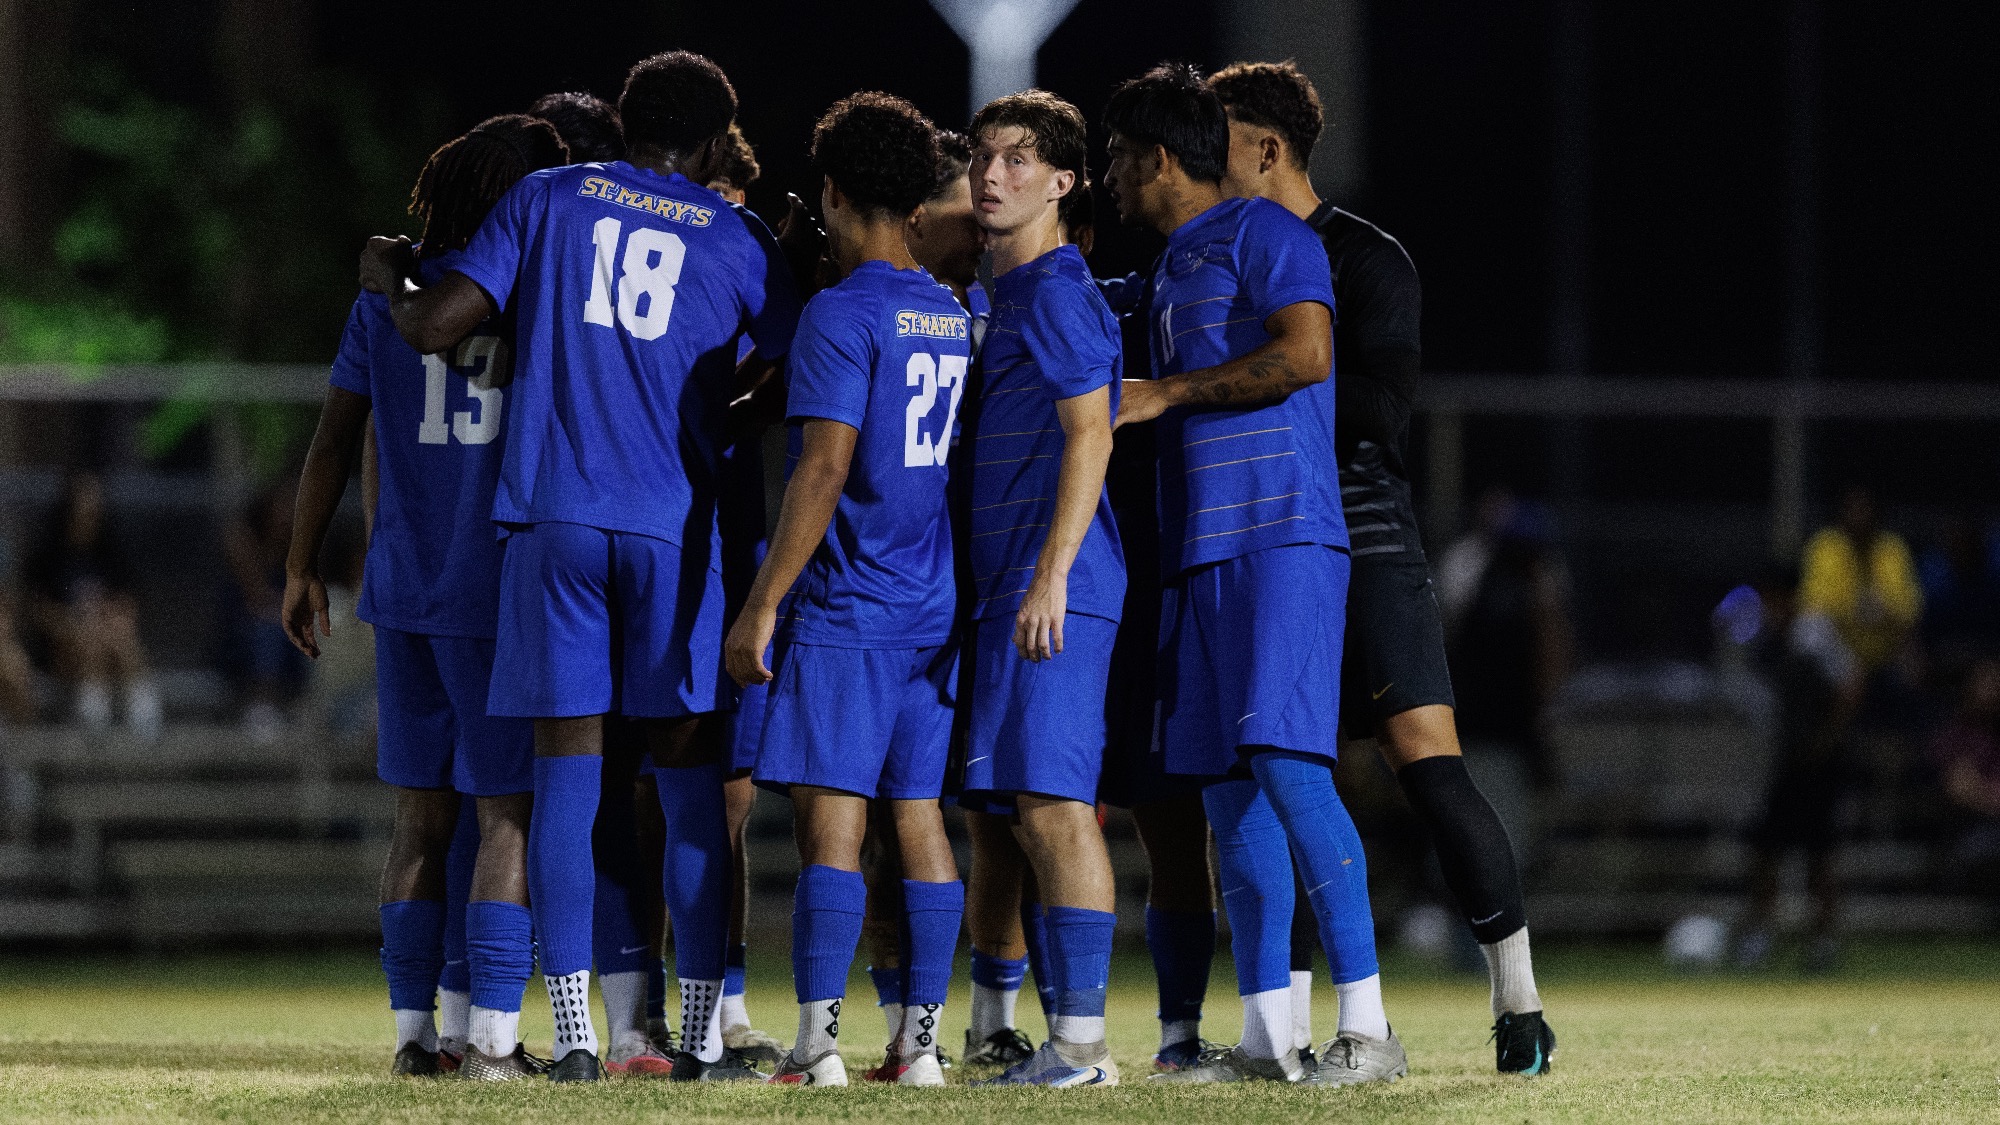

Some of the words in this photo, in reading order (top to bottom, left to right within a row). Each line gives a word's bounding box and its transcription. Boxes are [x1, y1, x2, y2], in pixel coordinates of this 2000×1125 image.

[583, 216, 687, 341] 18
[418, 335, 508, 445] 13
[904, 352, 969, 468] 27
